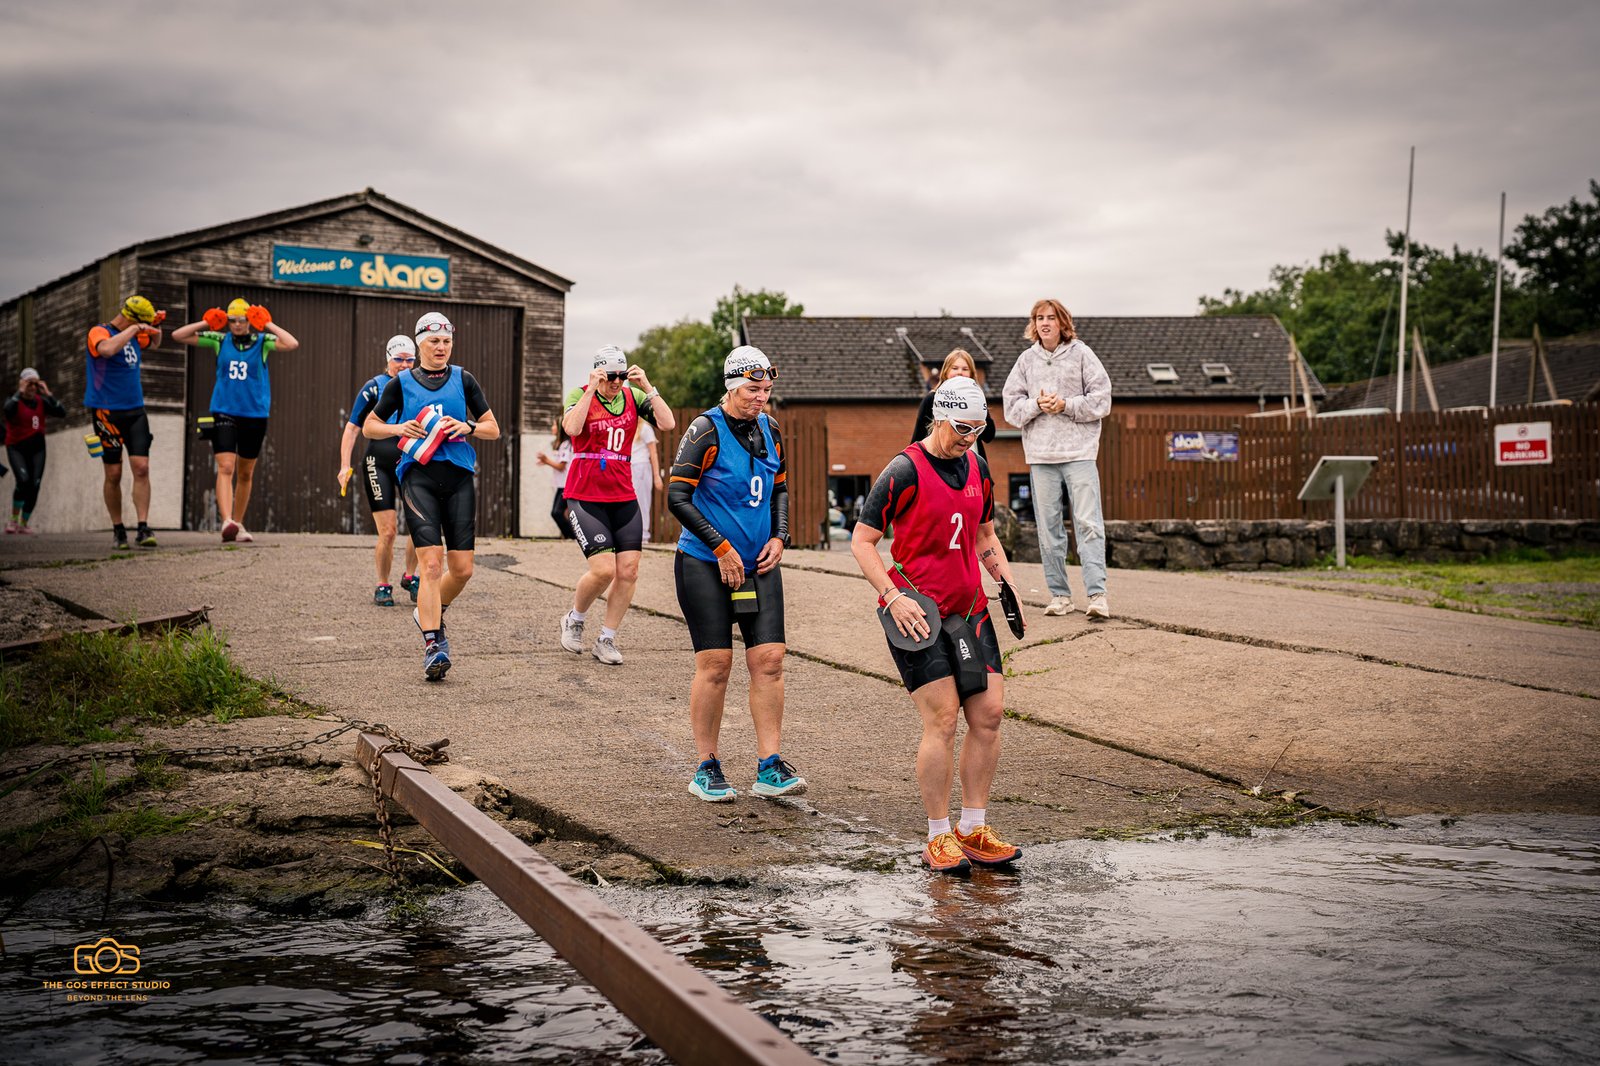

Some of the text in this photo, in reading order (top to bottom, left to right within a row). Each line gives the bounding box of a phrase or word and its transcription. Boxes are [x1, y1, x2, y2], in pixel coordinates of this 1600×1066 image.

[276, 255, 447, 291] Welcome to share
[123, 345, 138, 364] 53
[228, 360, 248, 380] 53
[32, 415, 39, 430] 8
[606, 426, 625, 452] 10
[1515, 441, 1531, 450] NO
[1502, 450, 1545, 460] PARKING
[366, 455, 383, 501] NEPTUNE
[748, 475, 763, 507] 9
[569, 510, 589, 551] FINGAL
[949, 512, 963, 550] 2
